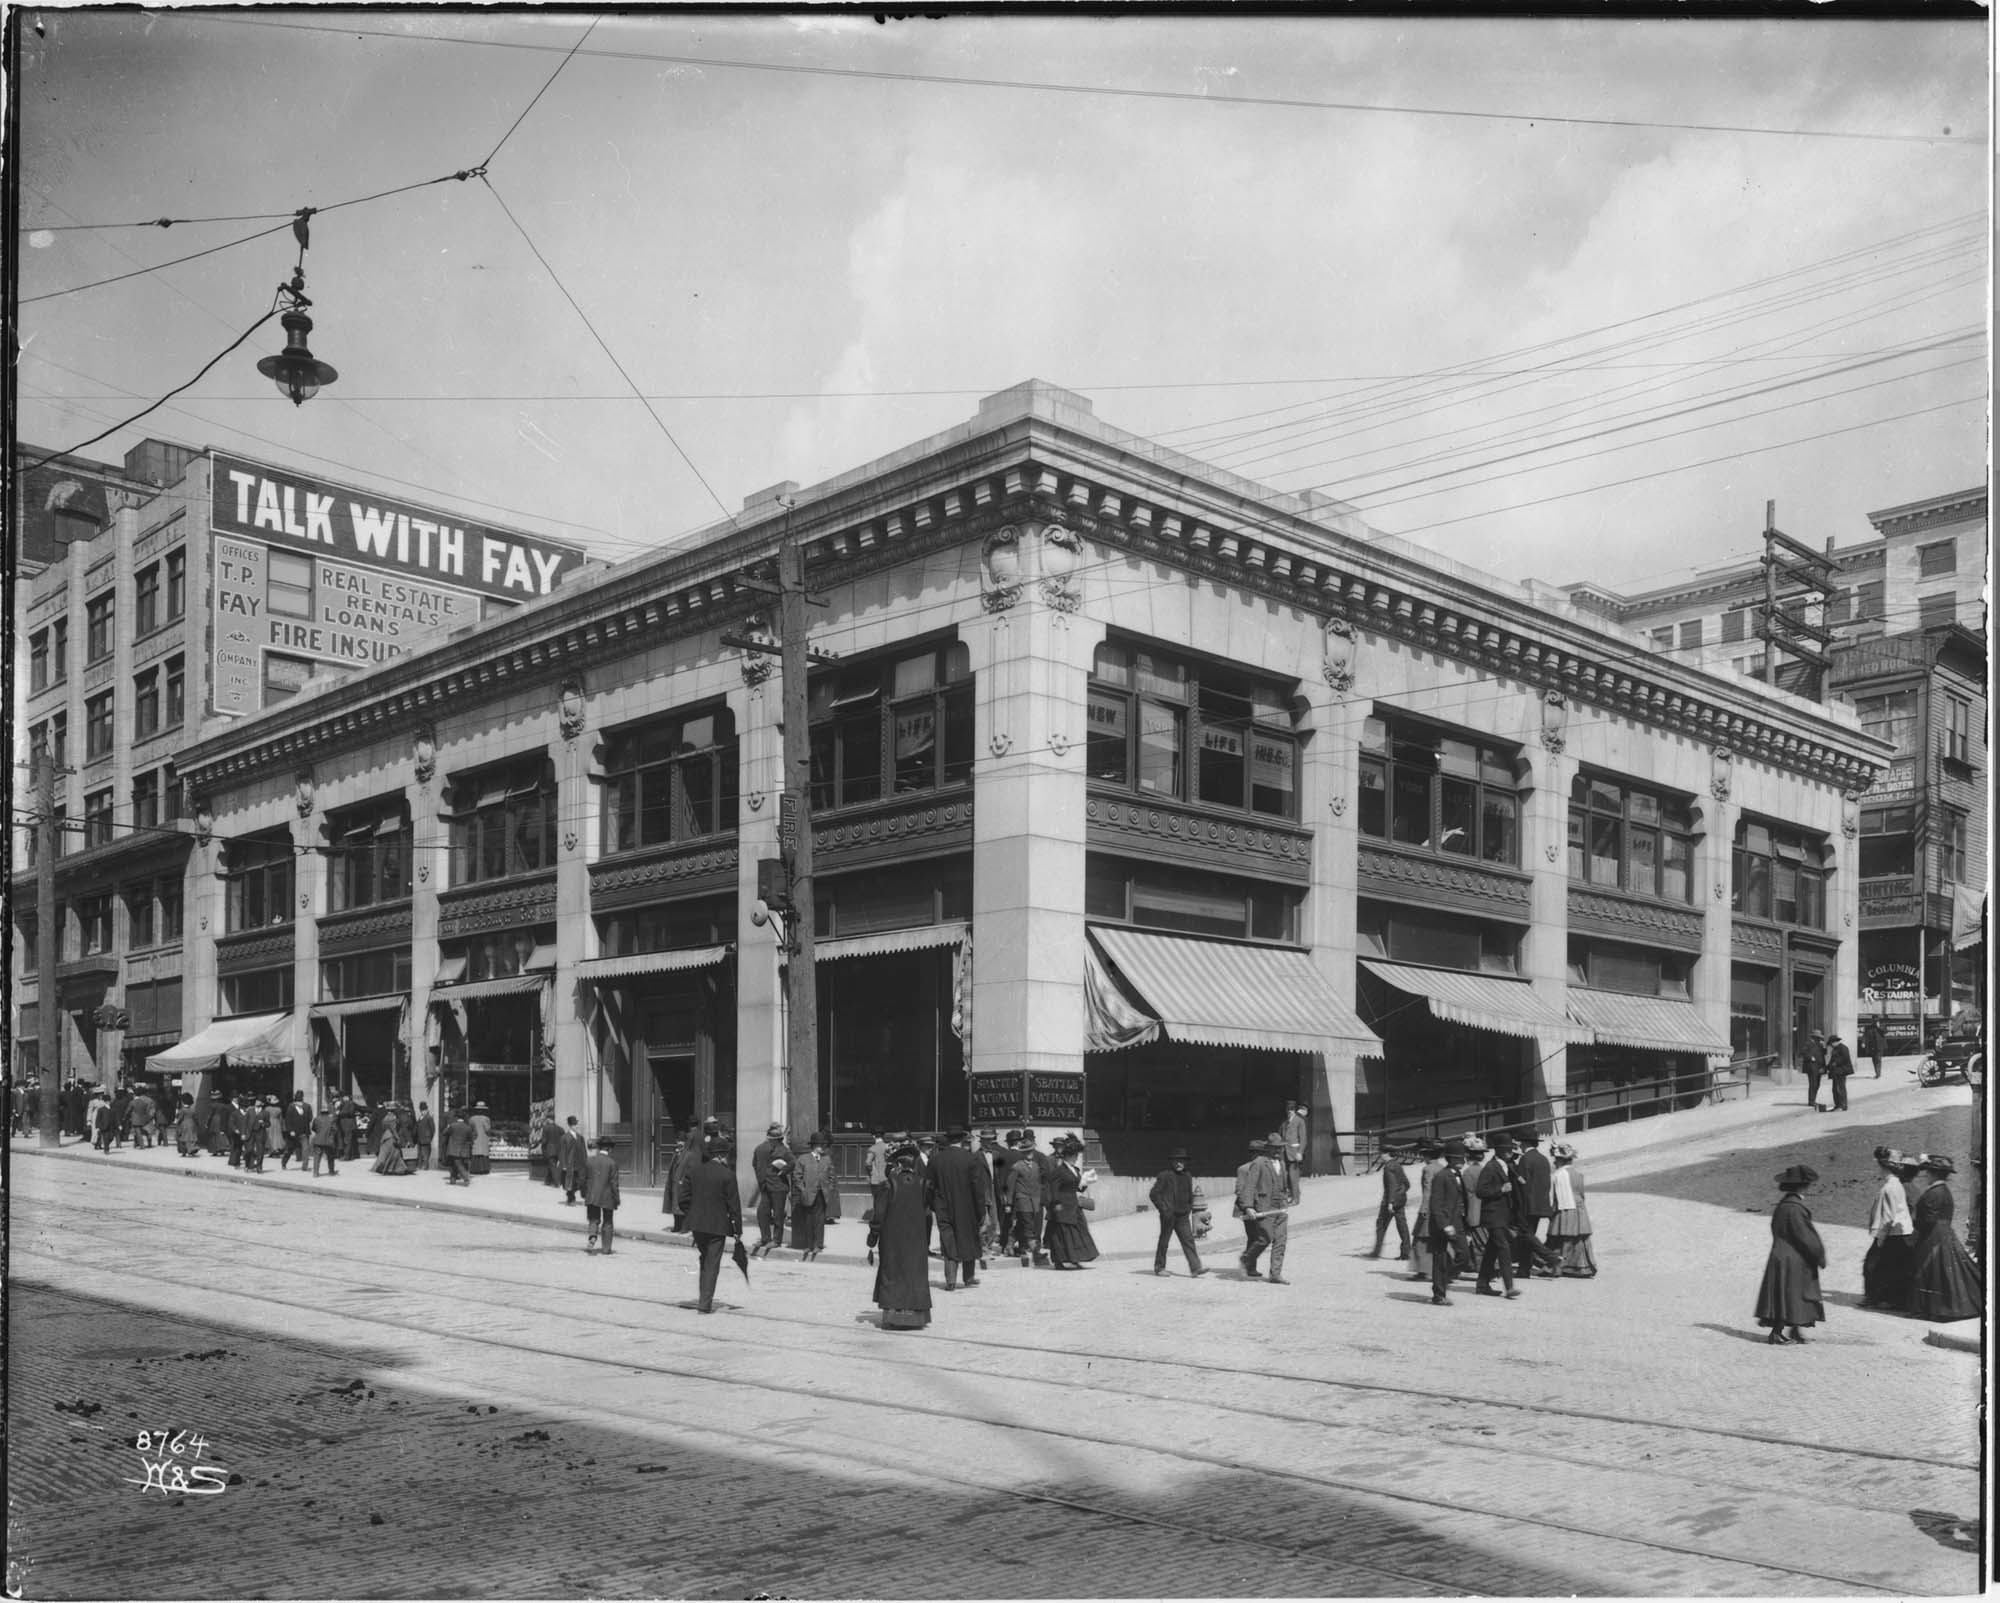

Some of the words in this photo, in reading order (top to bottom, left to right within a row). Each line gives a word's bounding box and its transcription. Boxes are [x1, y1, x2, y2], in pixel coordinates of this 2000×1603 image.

[229, 470, 334, 544] TALK
[350, 502, 464, 575] WITH
[482, 536, 562, 595] FAY
[222, 545, 259, 562] OFFICES
[220, 562, 255, 585] T.P.
[322, 567, 371, 595] REAL
[219, 590, 261, 617] FAY
[346, 594, 439, 626] RENTALS
[324, 607, 400, 636] LOANS
[270, 621, 322, 651] FIRE
[217, 649, 257, 667] COMPANY
[784, 797, 798, 850] FIRE
[1868, 963, 1920, 979] COLUMBIA
[1035, 1077, 1079, 1090] SEATTLE
[1031, 1092, 1083, 1104] NATIONAL
[978, 1106, 1017, 1118] BANK
[1036, 1107, 1077, 1119] BANK
